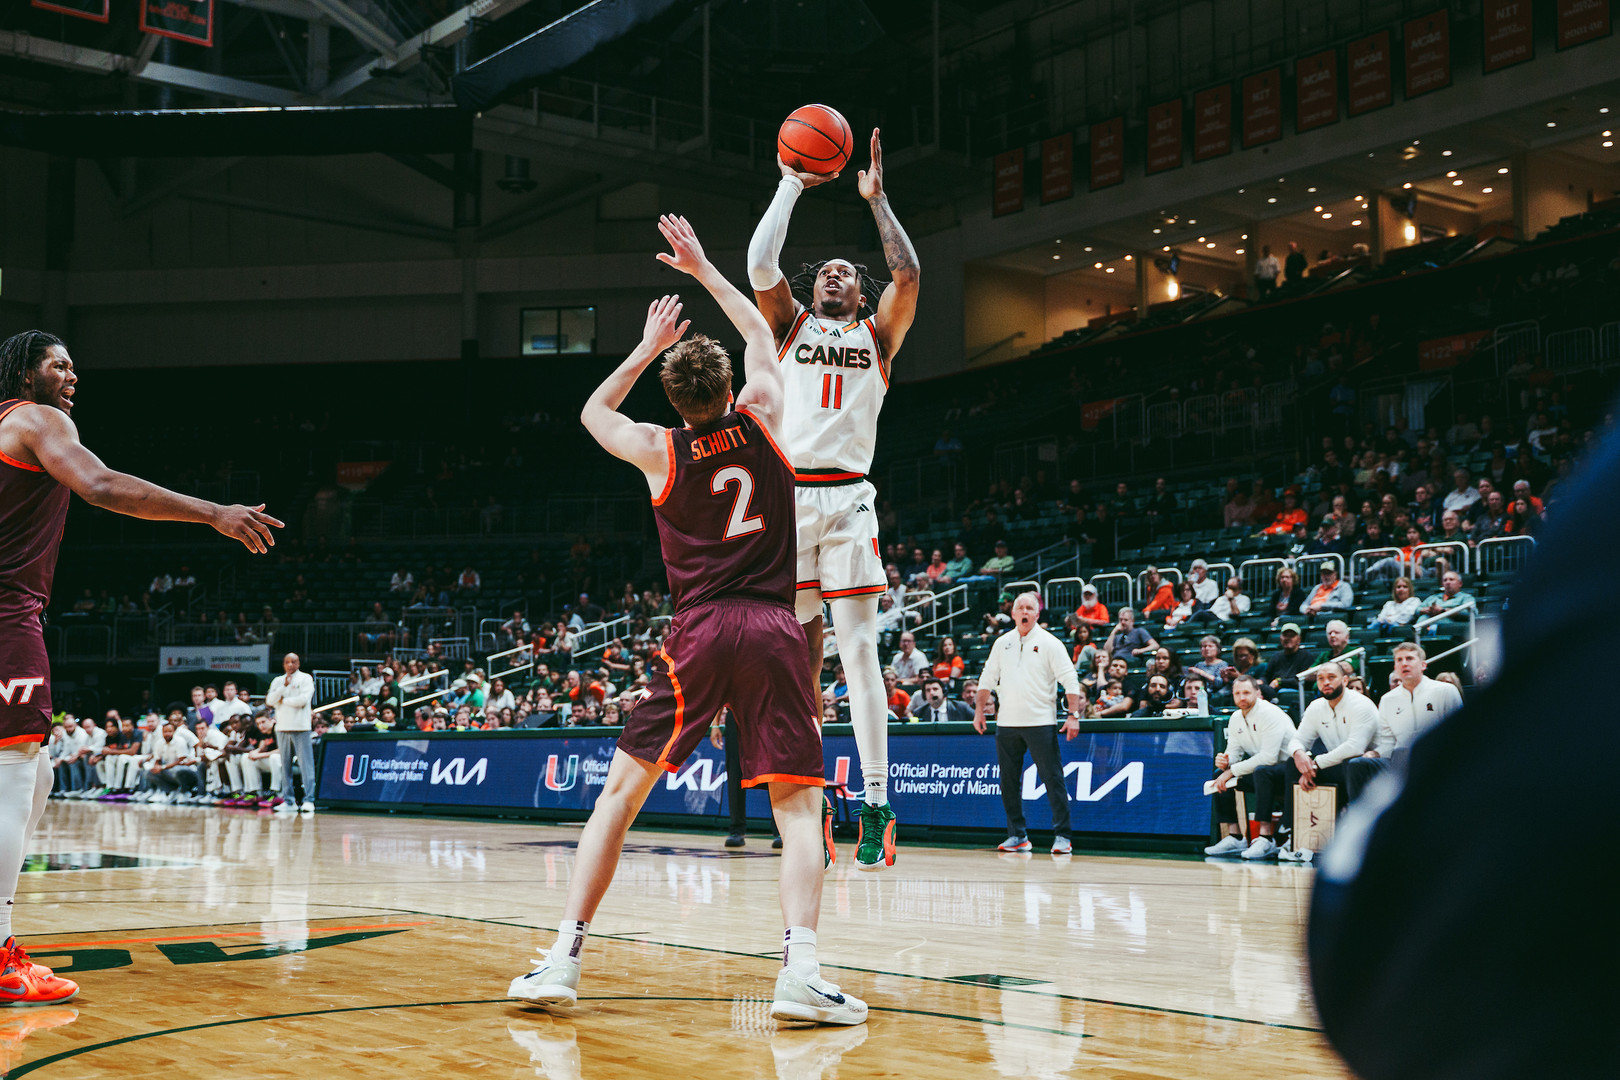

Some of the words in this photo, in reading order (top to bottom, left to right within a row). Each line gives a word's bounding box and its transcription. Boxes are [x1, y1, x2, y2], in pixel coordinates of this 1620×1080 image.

[1496, 3, 1519, 20] NIT
[795, 343, 872, 370] CANES
[821, 373, 843, 410] 11
[690, 425, 749, 461] SCHUTT
[710, 464, 766, 541] 2
[370, 758, 390, 770] Official
[391, 759, 411, 770] Partner
[418, 760, 428, 770] the
[582, 759, 609, 773] Official
[889, 763, 928, 778] Official
[931, 764, 974, 779] Partner
[976, 763, 990, 779] of
[372, 770, 398, 783] University
[406, 771, 424, 781] Miami
[895, 779, 949, 798] University
[952, 779, 965, 795] of
